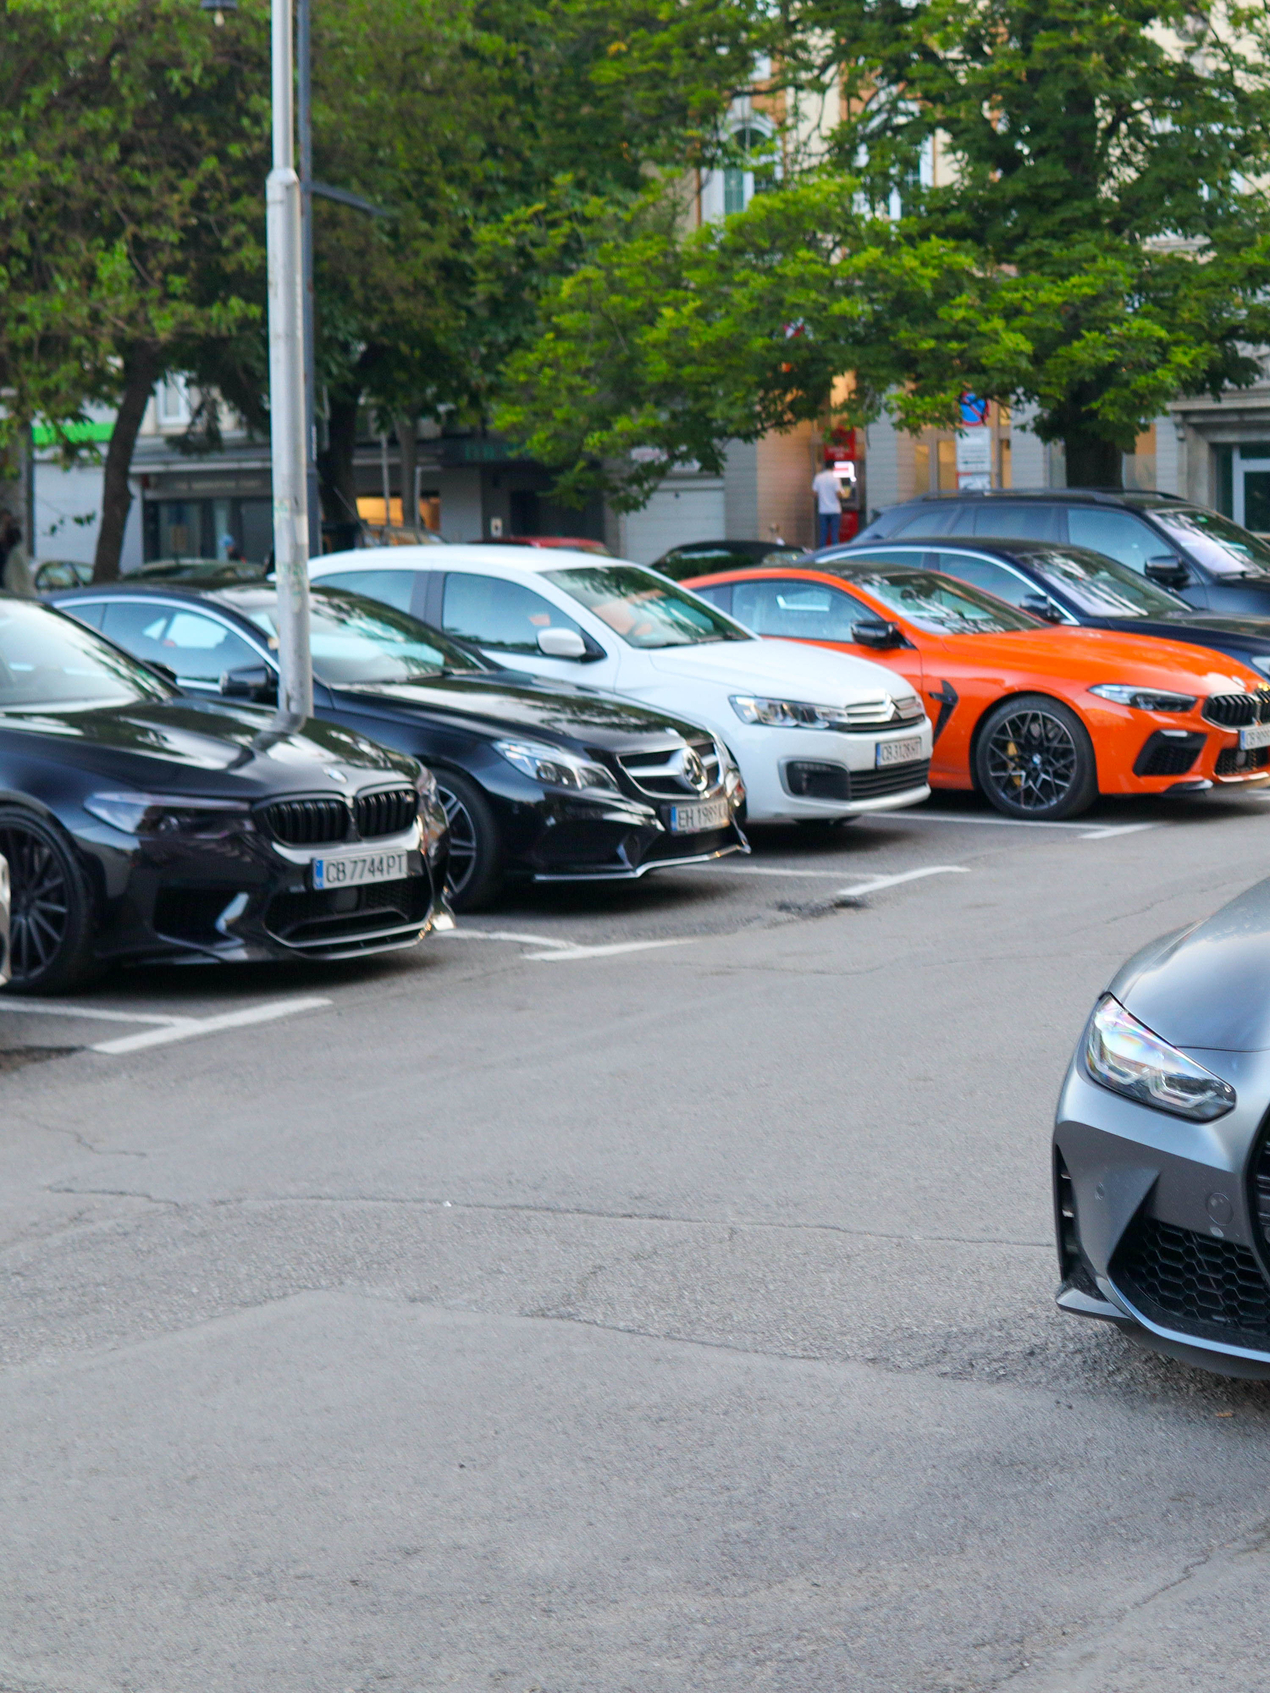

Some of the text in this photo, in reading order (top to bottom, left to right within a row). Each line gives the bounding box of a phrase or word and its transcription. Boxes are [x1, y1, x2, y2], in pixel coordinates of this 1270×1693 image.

[677, 807, 694, 828] EH
[326, 854, 405, 883] CB 7744 PT
